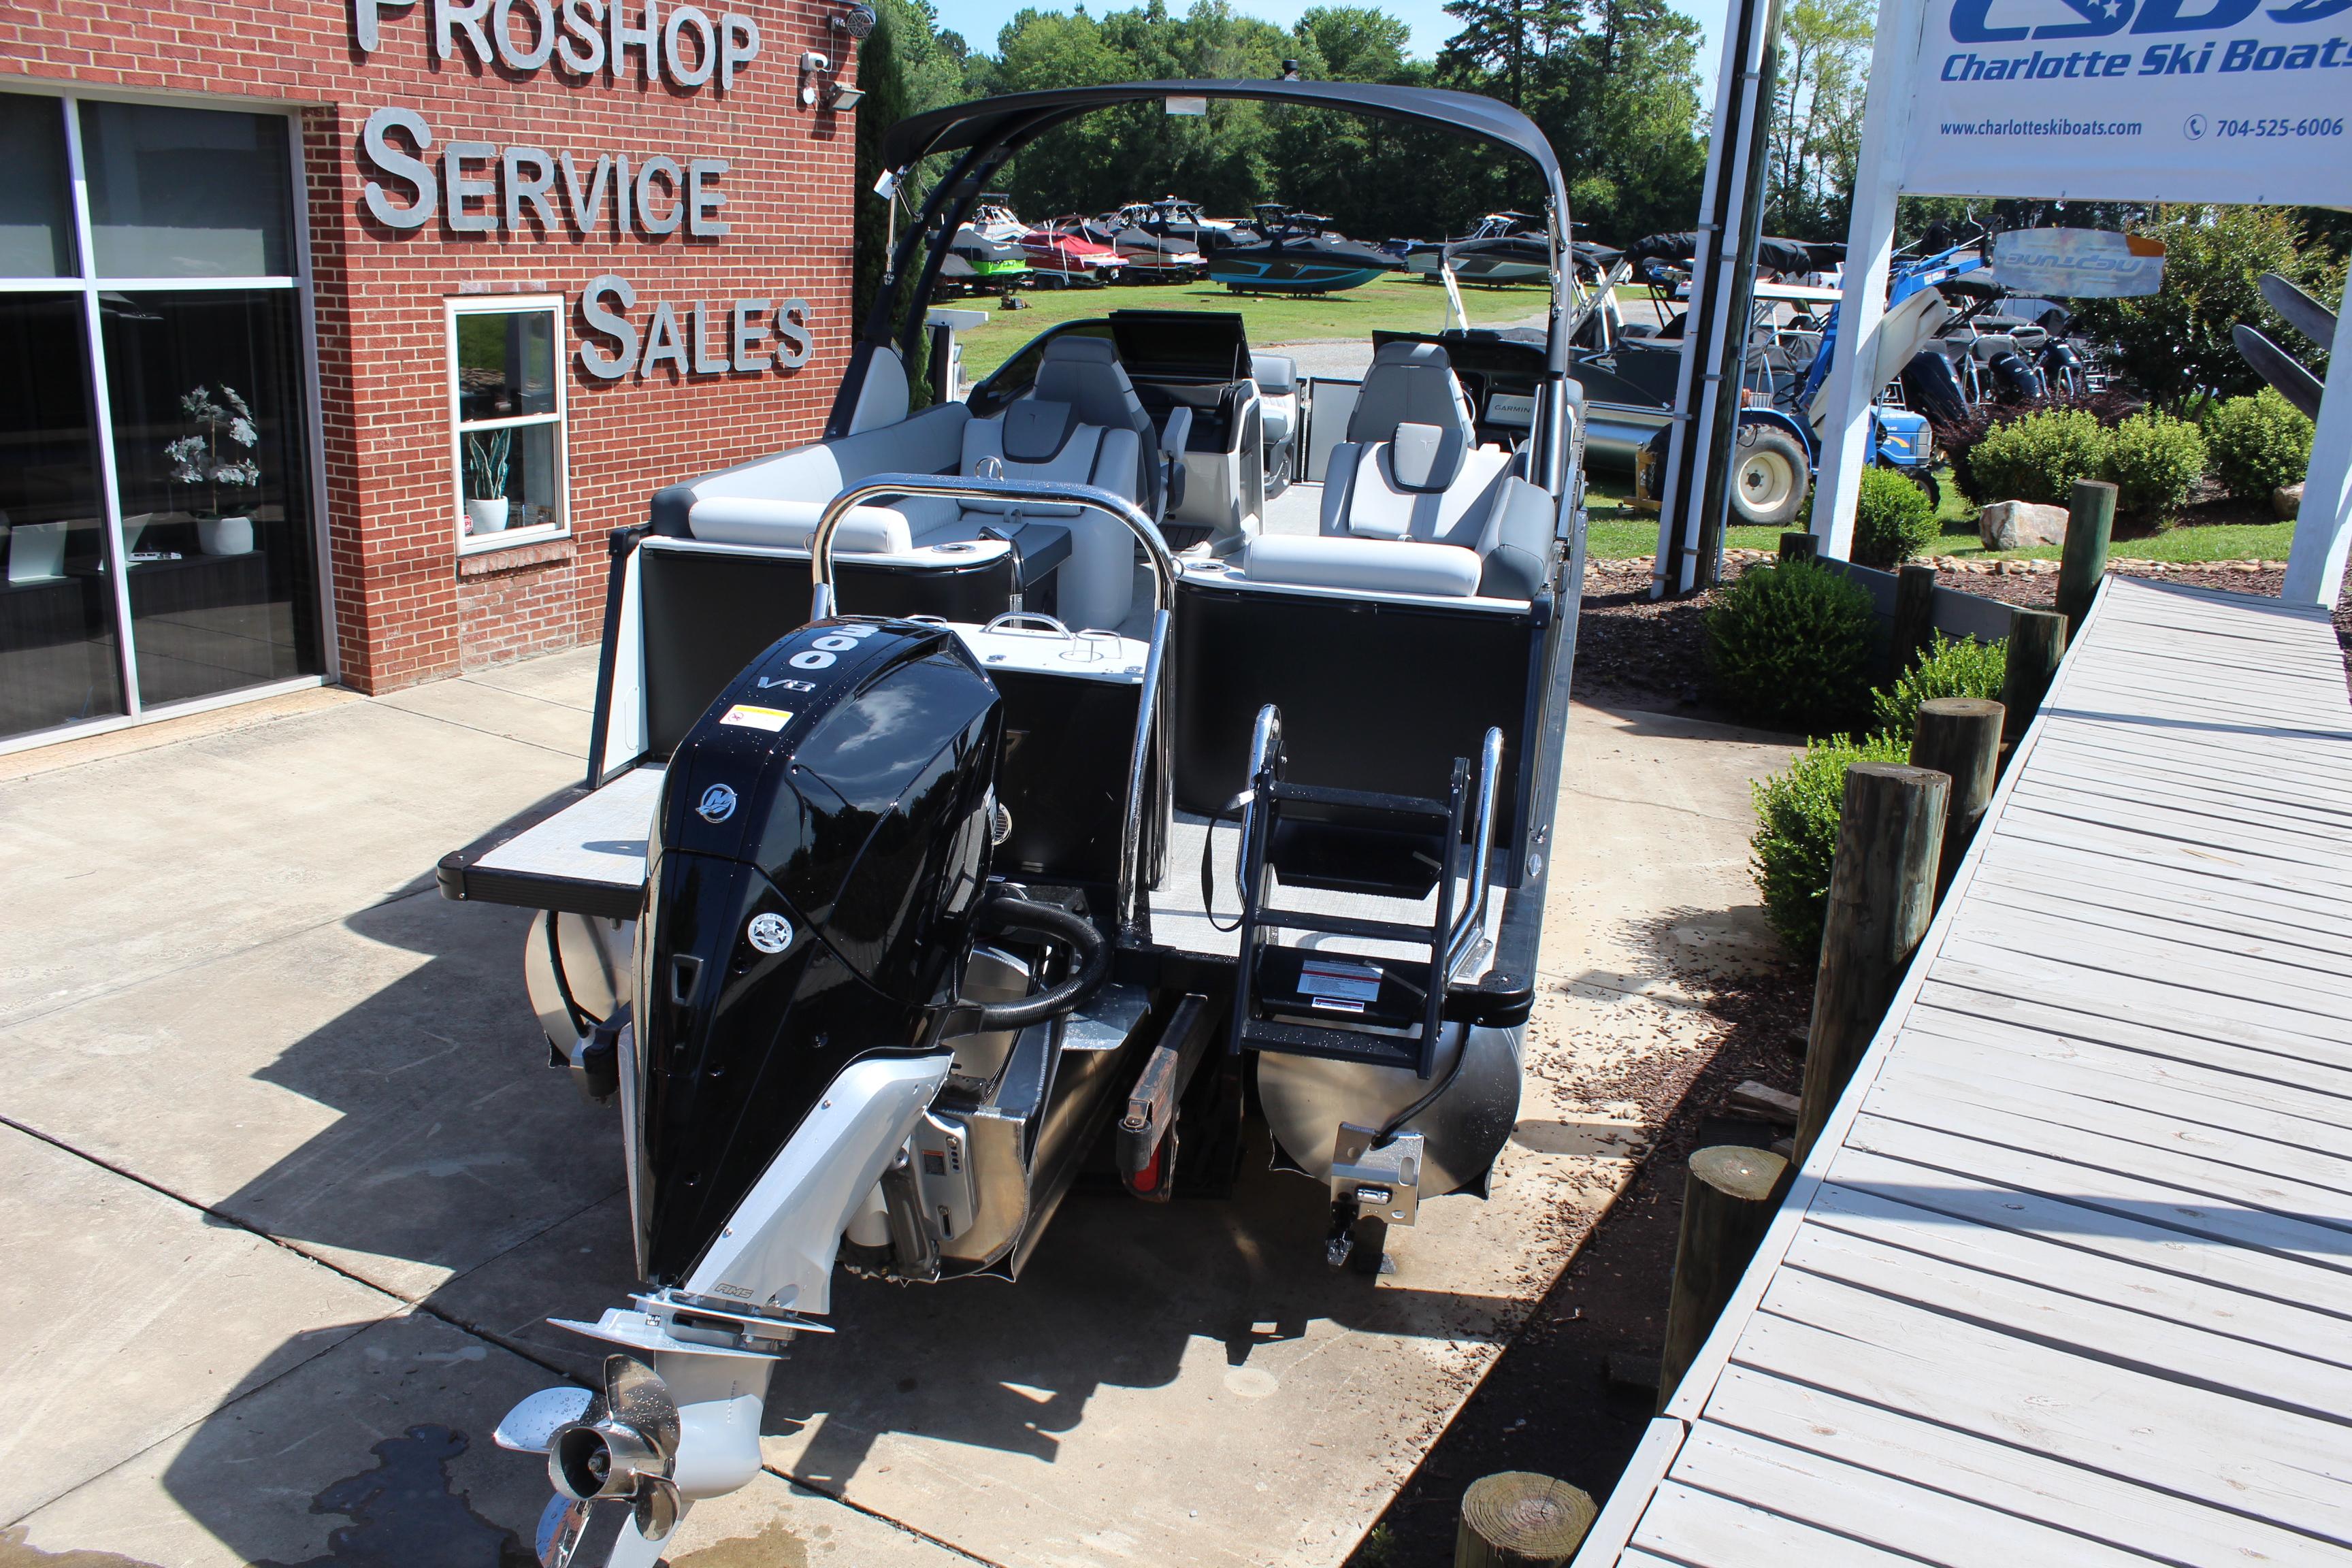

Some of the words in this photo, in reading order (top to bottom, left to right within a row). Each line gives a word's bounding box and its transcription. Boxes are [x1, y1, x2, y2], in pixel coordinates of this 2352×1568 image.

[1940, 49, 2132, 82] Charlotte
[2138, 42, 2216, 76] Ski
[1940, 118, 2142, 136] www.charlotteskiboats.com
[2216, 117, 2344, 137] 704-525-6006
[1494, 404, 1531, 413] GARMIN
[757, 676, 817, 693] V8
[714, 1283, 755, 1299] AMS
